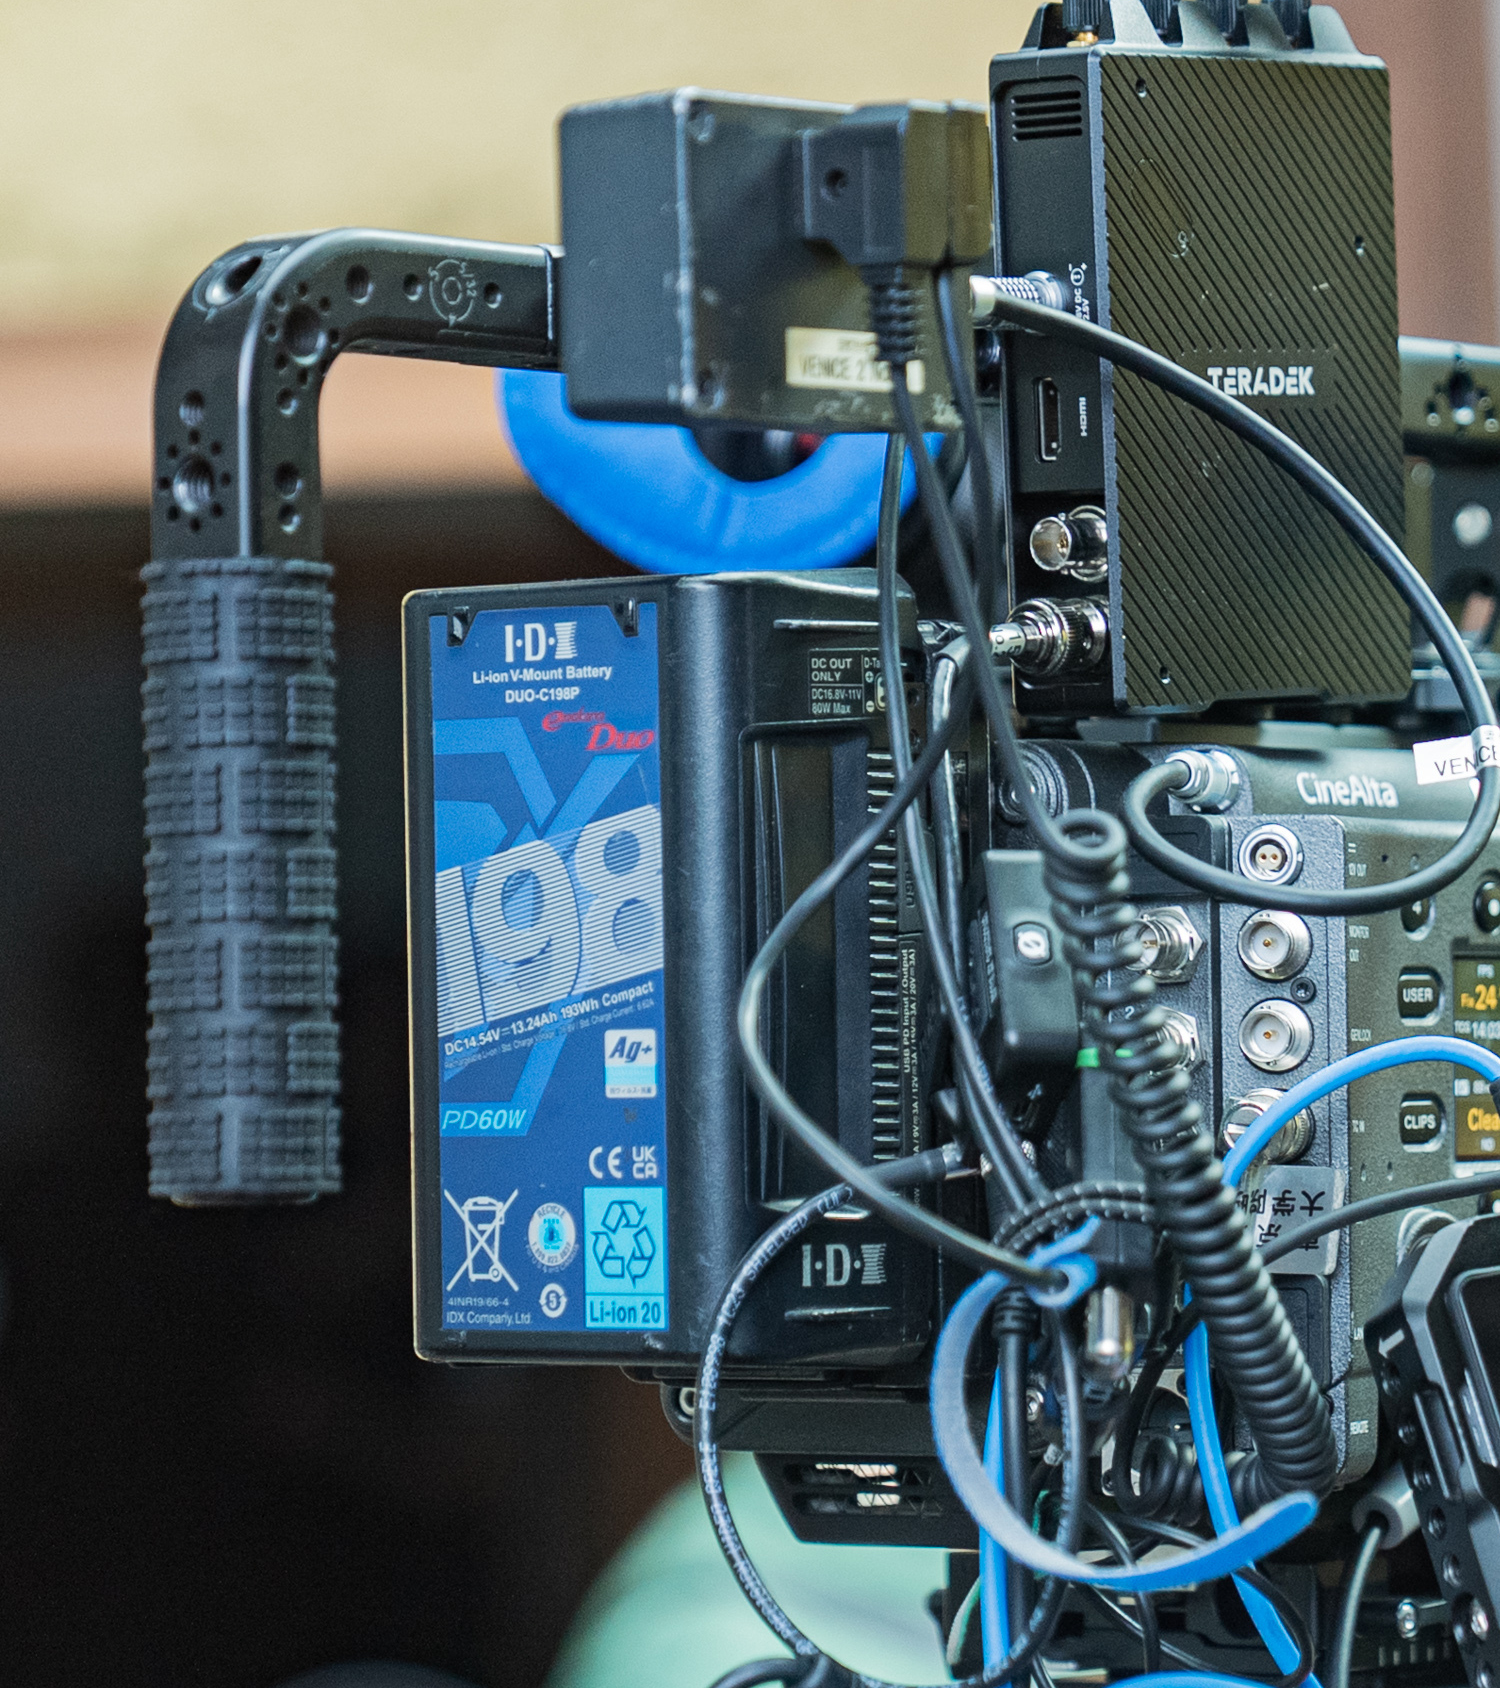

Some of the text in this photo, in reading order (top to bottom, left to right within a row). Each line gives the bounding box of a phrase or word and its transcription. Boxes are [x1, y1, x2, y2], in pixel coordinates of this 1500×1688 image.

[1207, 366, 1315, 396] TERADEK
[811, 657, 881, 669] DC OUT D-Ta
[472, 665, 613, 685] Li-ion V-Mount Battery
[811, 671, 842, 682] ONLY
[504, 686, 581, 704] DUO-C198P
[585, 722, 655, 751] Duo
[1295, 771, 1400, 808] CineAlta
[560, 998, 600, 1019] 193Wh
[602, 980, 655, 1007] Compact
[1403, 988, 1434, 1003] USER
[608, 1035, 654, 1064] Ag+
[441, 1109, 527, 1131] PD60W
[1404, 1115, 1436, 1130] CLIPS
[745, 1213, 810, 1283] SHIELDED
[446, 1311, 465, 1325] IDX
[589, 1301, 662, 1324] Li-ion 20
